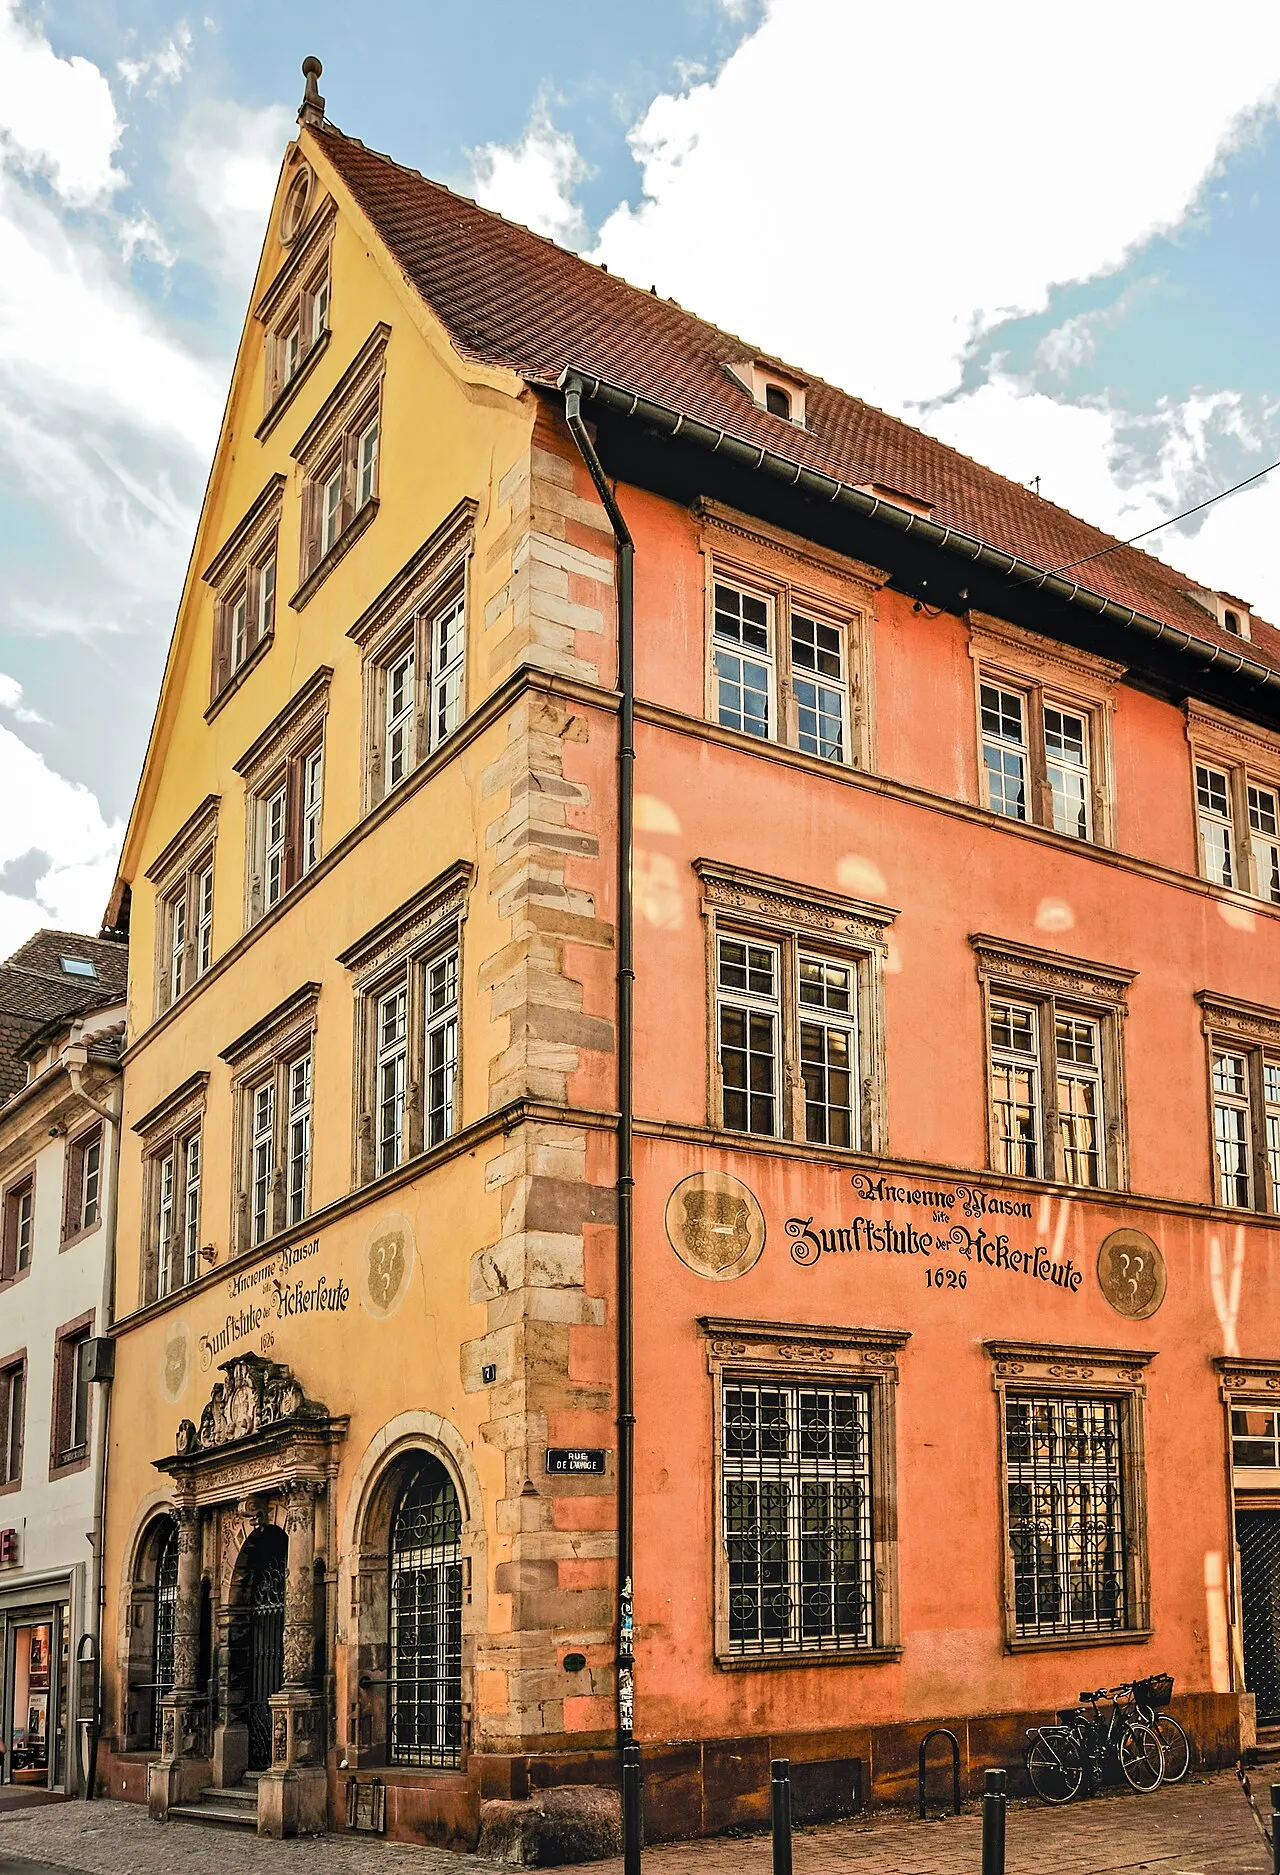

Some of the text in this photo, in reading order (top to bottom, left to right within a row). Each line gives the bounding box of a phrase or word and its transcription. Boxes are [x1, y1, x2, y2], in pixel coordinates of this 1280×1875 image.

[851, 1173, 1032, 1218] Ancienne Maison
[227, 1238, 320, 1298] Ancienne Maison
[785, 1216, 1083, 1292] Zunftstube der Ackerleute
[925, 1267, 968, 1290] 1626
[199, 1304, 262, 1372] Zunftstube
[270, 1276, 350, 1319] Ackerleute
[260, 1331, 275, 1352] 1626
[556, 1460, 567, 1469] DE
[568, 1452, 588, 1460] RUE
